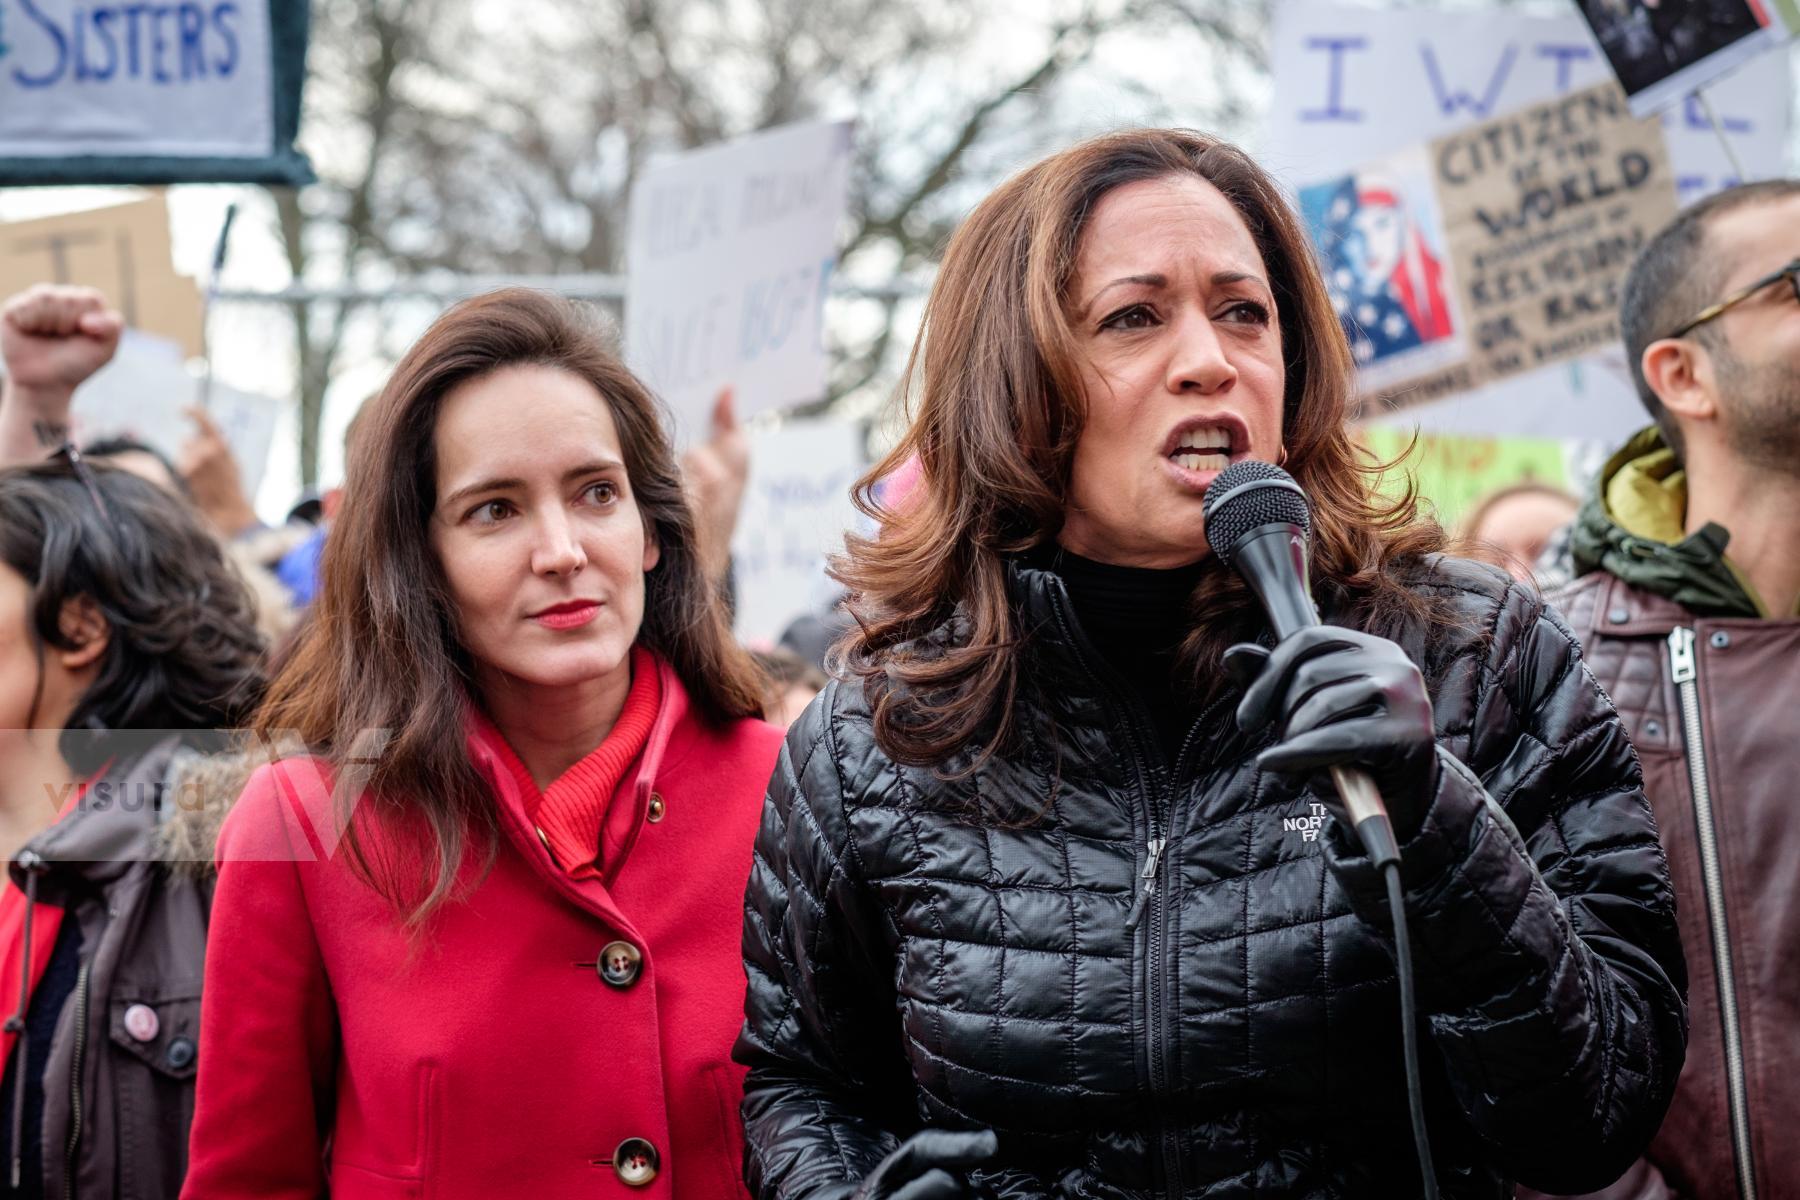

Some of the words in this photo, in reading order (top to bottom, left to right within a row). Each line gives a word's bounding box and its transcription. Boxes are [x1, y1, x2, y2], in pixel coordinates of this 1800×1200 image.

[11, 0, 241, 89] SISTERS
[1298, 37, 1367, 122] I
[1438, 89, 1622, 185] CITIZEN
[1473, 151, 1652, 237] WORLD
[1283, 815, 1325, 832] NOR
